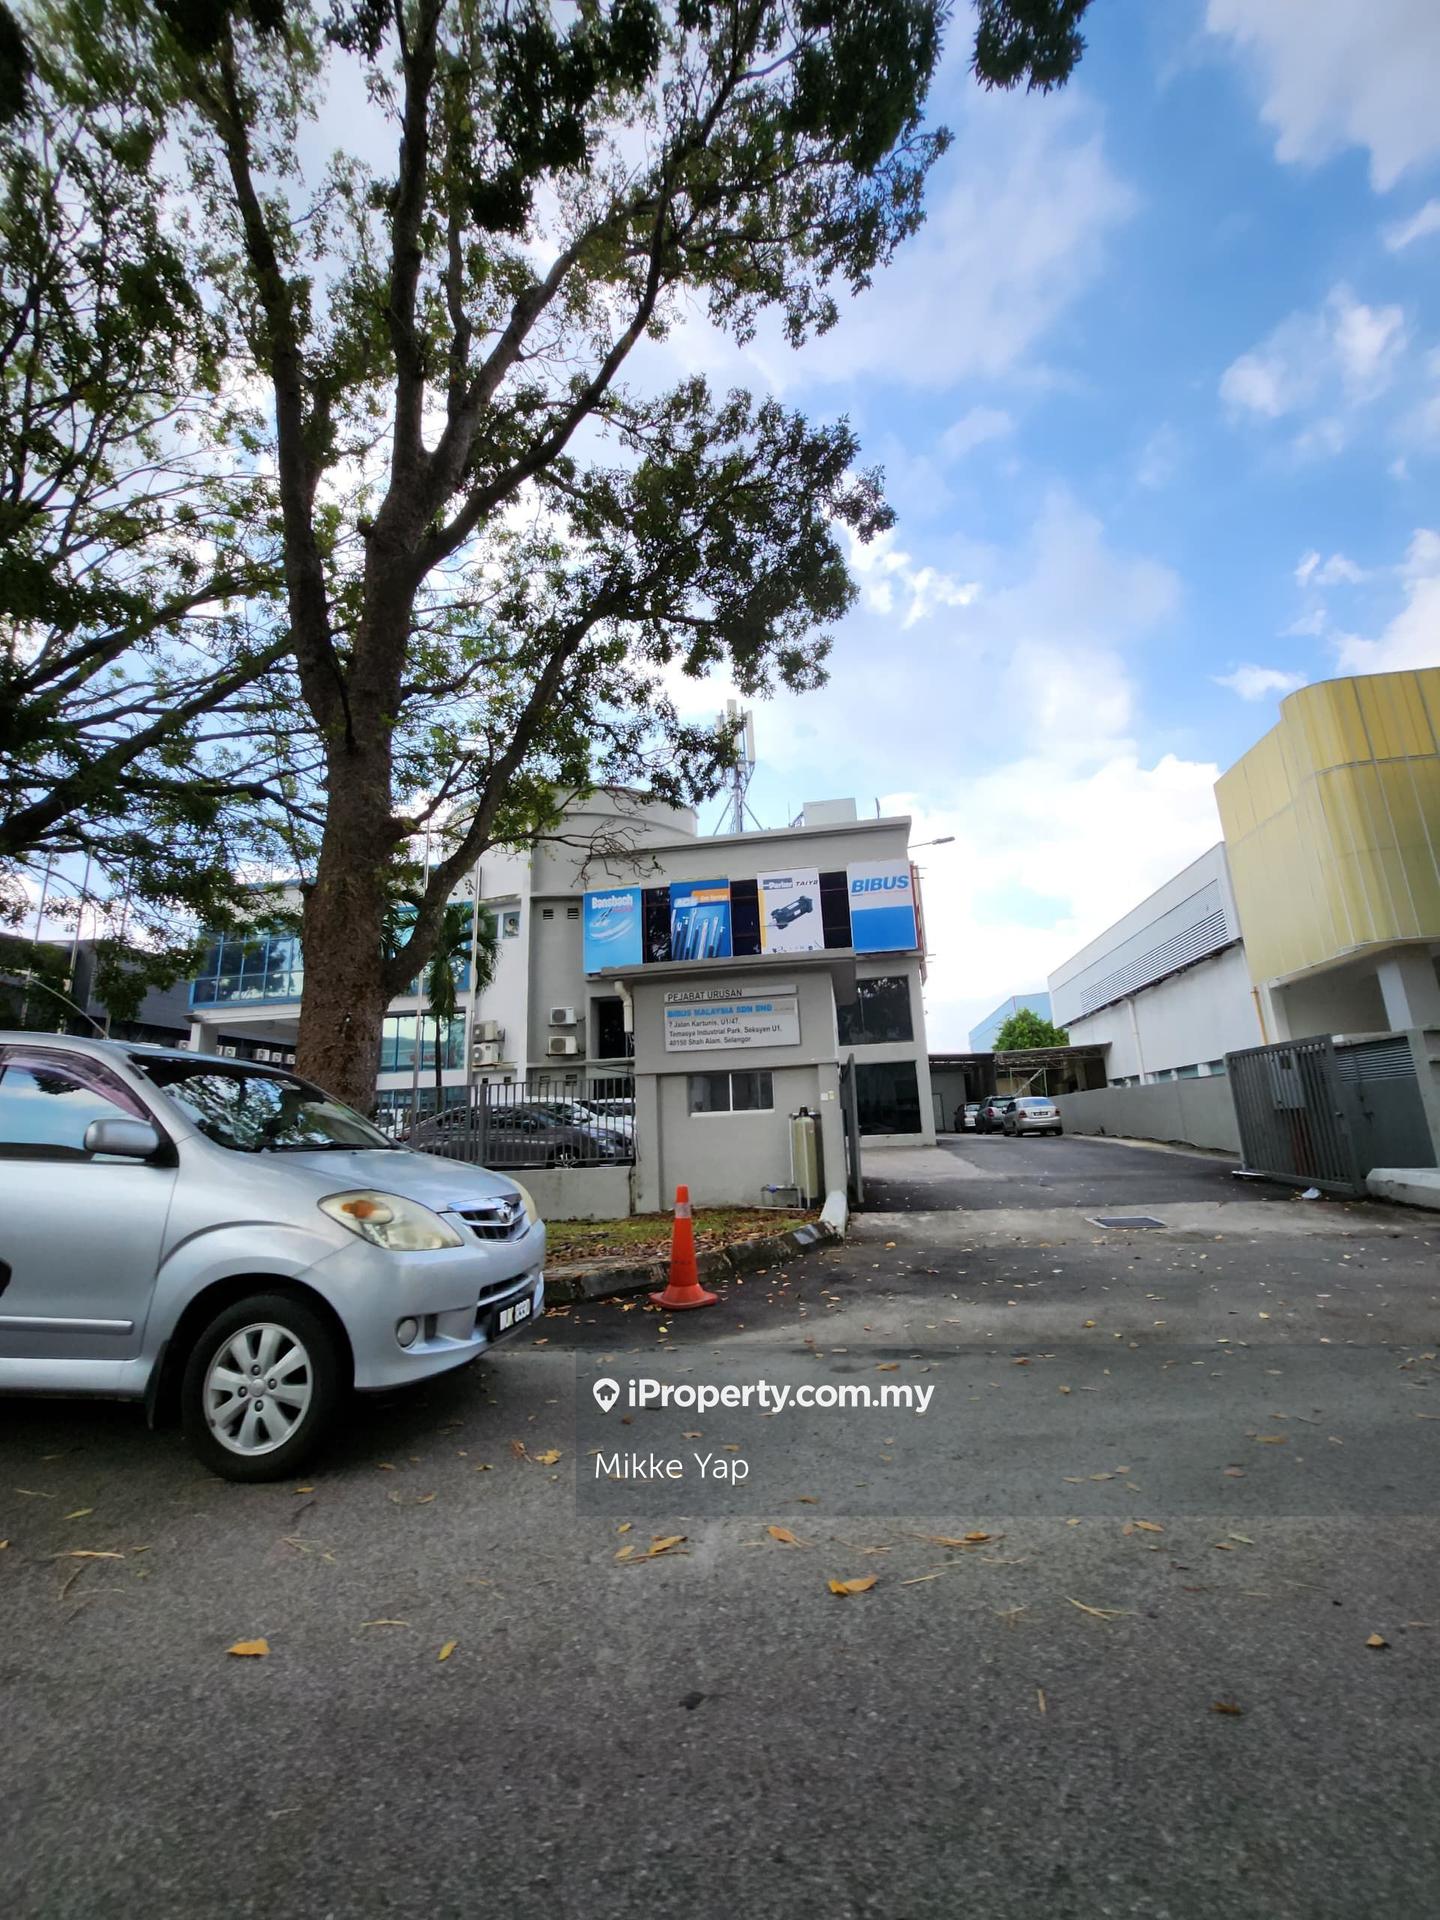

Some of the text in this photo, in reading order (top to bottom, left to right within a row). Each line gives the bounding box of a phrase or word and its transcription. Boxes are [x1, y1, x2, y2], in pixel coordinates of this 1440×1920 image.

[851, 875, 909, 894] BIBUS
[667, 989, 743, 1001] PEJABAT URUSAN
[693, 1006, 734, 1016] MALAYSIA
[736, 1005, 753, 1013] SDN
[697, 1028, 726, 1036] Industrial
[688, 1038, 705, 1046] Shah
